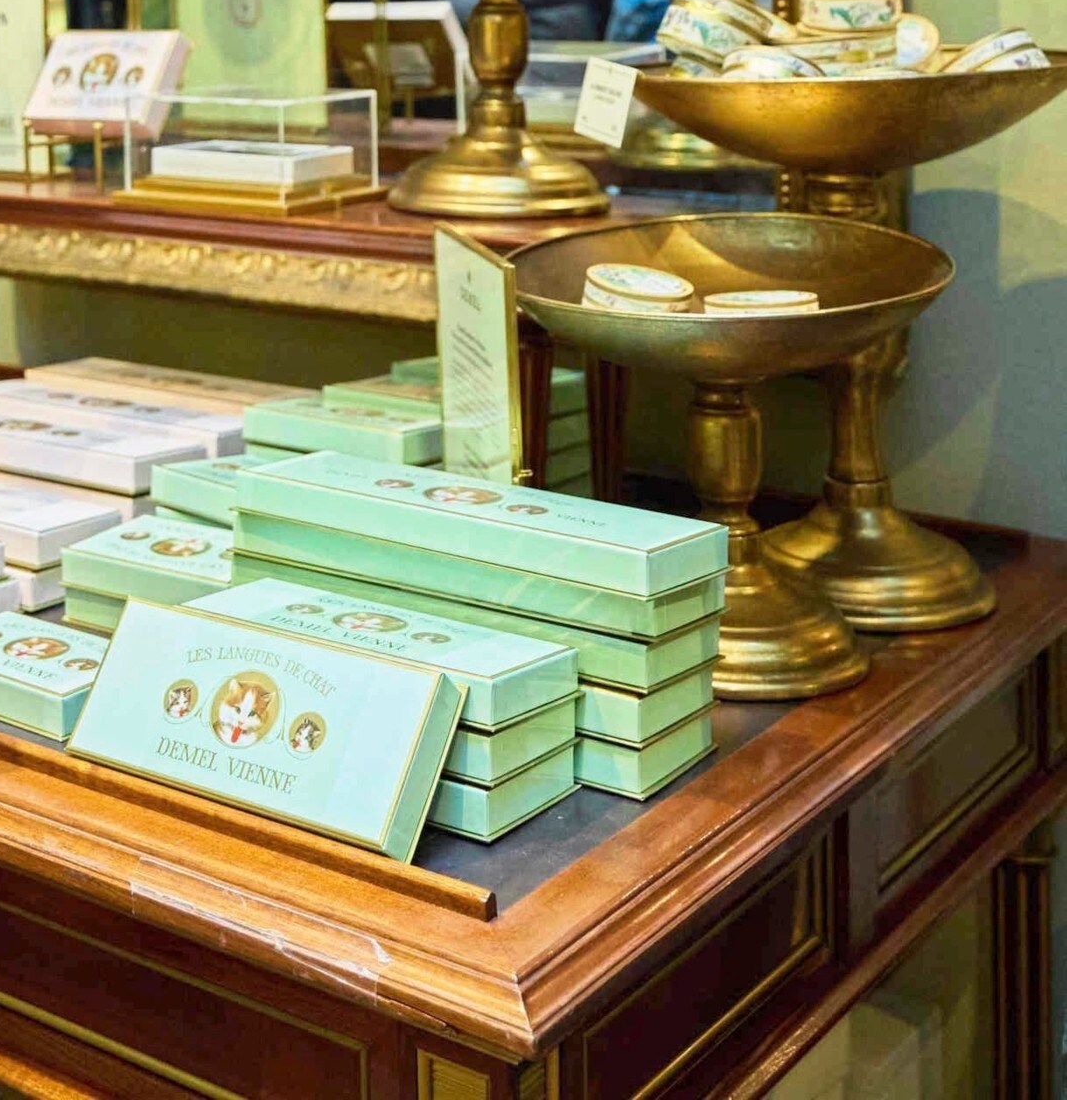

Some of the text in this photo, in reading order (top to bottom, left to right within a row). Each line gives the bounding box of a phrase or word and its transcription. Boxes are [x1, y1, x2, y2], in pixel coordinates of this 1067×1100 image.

[187, 646, 337, 699] LES LANGUES DE CHAT
[156, 736, 298, 796] DEMEL VIENNE
